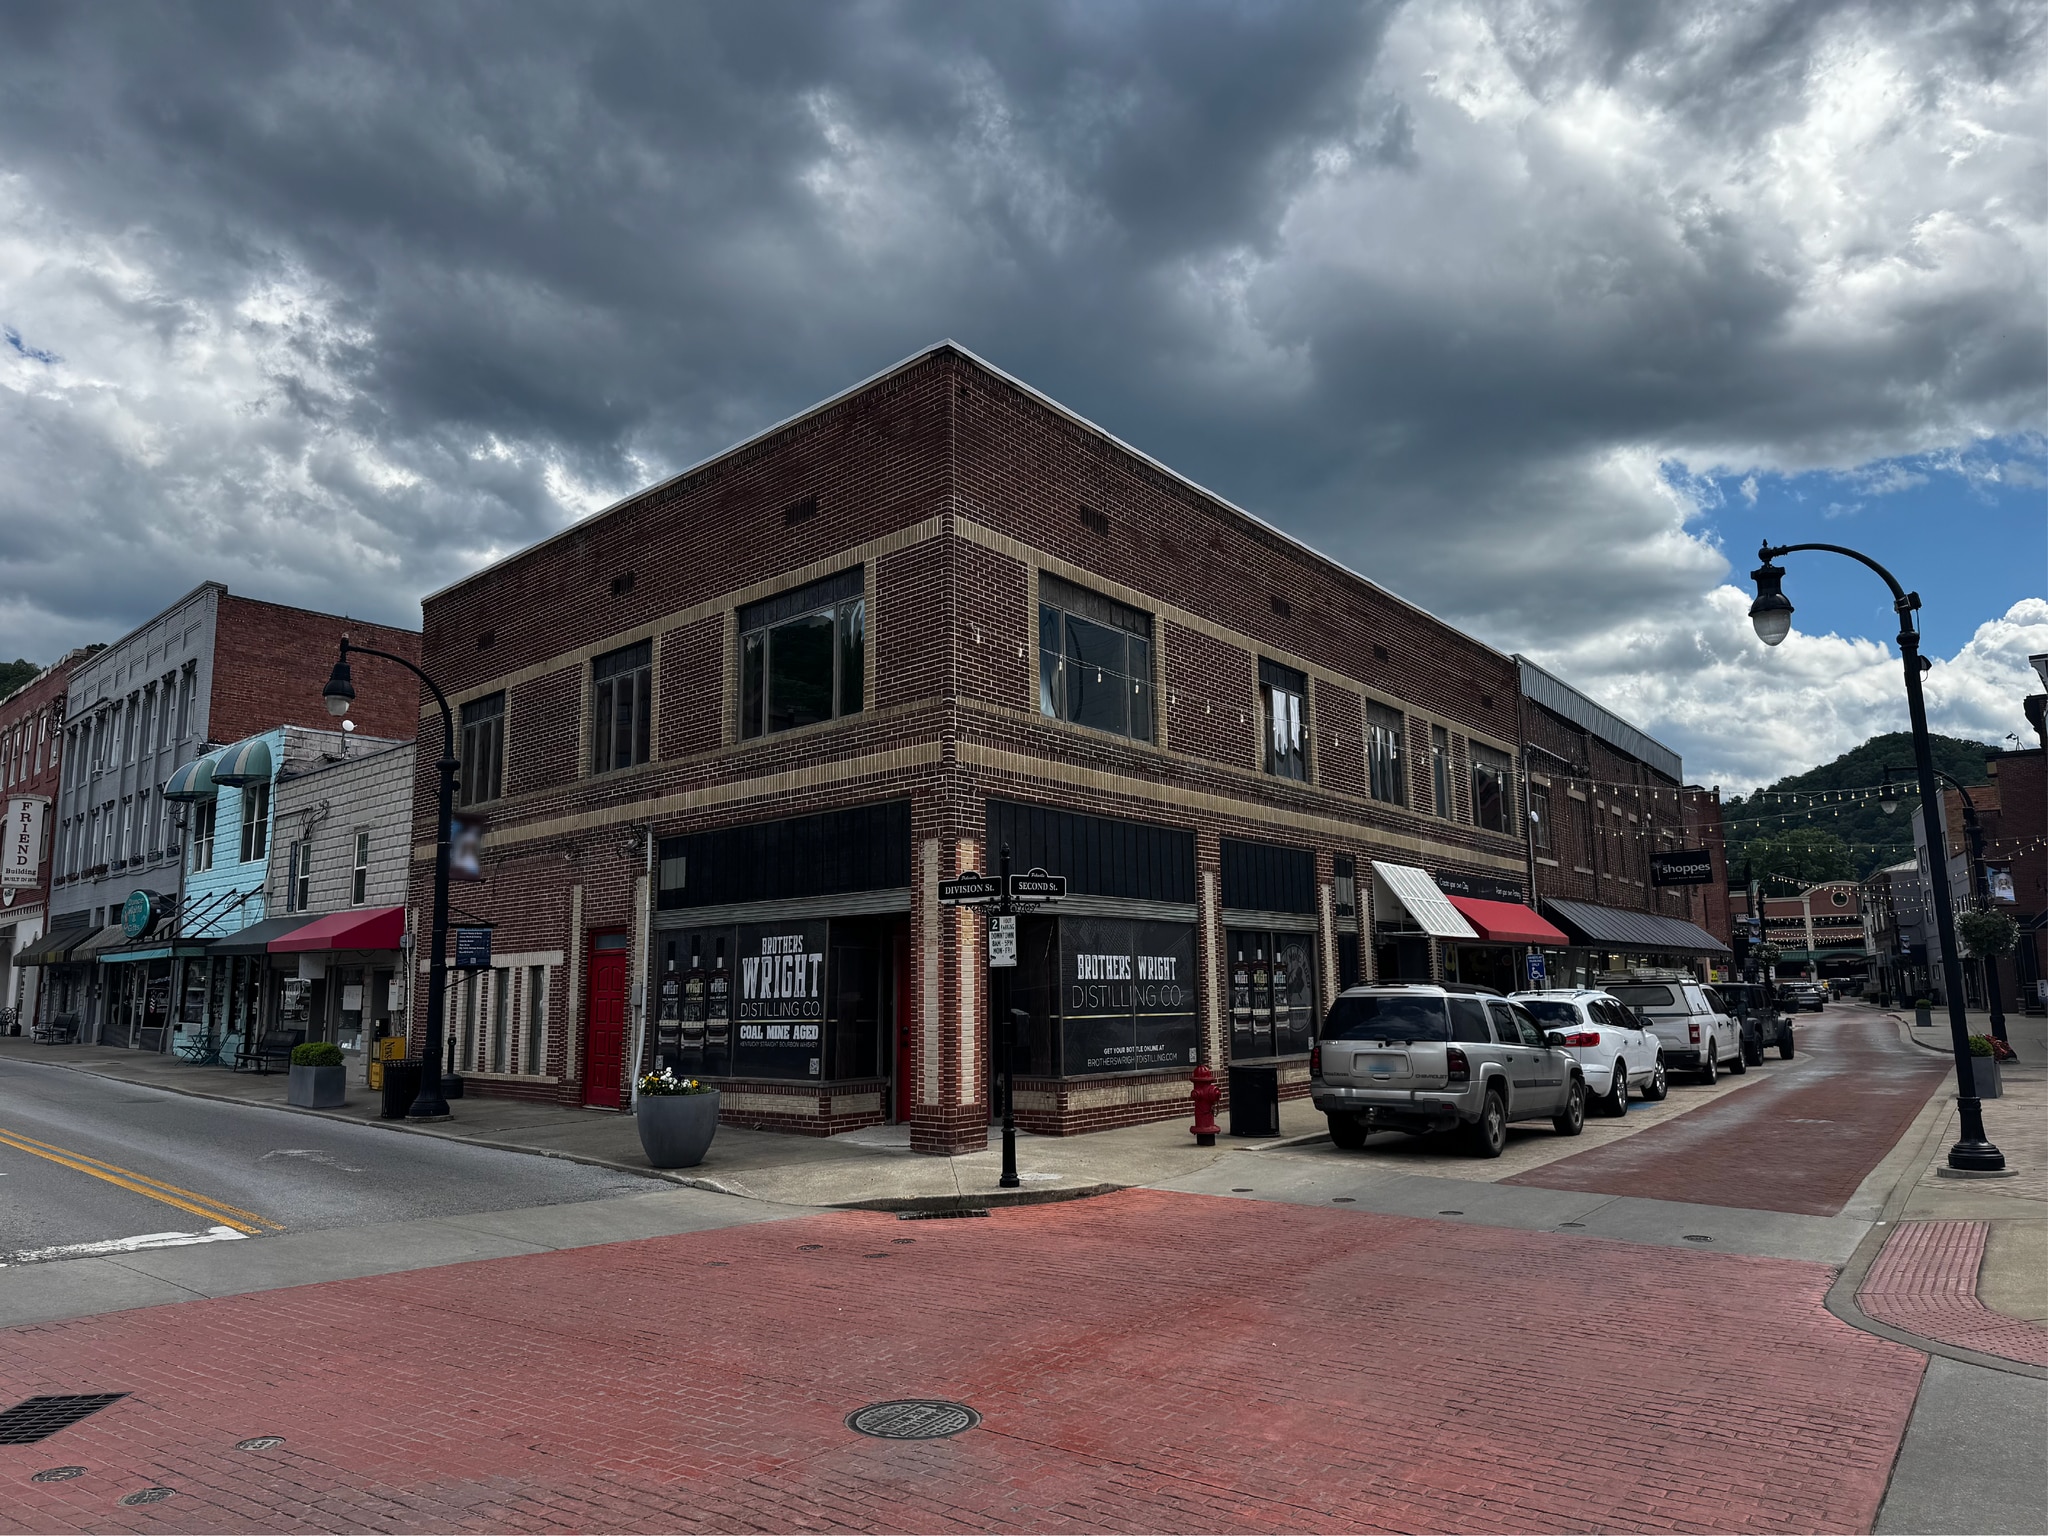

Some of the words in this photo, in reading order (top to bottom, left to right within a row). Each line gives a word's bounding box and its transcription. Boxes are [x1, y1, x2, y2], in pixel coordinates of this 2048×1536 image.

[17, 802, 33, 865] FRIEND
[945, 884, 983, 895] DIVISION
[984, 884, 995, 892] St.
[1018, 882, 1048, 891] SECOND
[1049, 882, 1058, 891] St.
[991, 919, 998, 930] 2
[762, 935, 803, 955] BROTHERS
[742, 953, 822, 999] WRIGHT
[1077, 954, 1131, 980] BROTHERS
[1137, 955, 1176, 981] WRIGHT
[1072, 985, 1157, 1008] DISTILLING
[740, 1001, 800, 1017] DISTILLING
[803, 1001, 822, 1016] CO.
[740, 1025, 764, 1040] COAL
[766, 1025, 791, 1040] MINE
[793, 1025, 819, 1040] AGED
